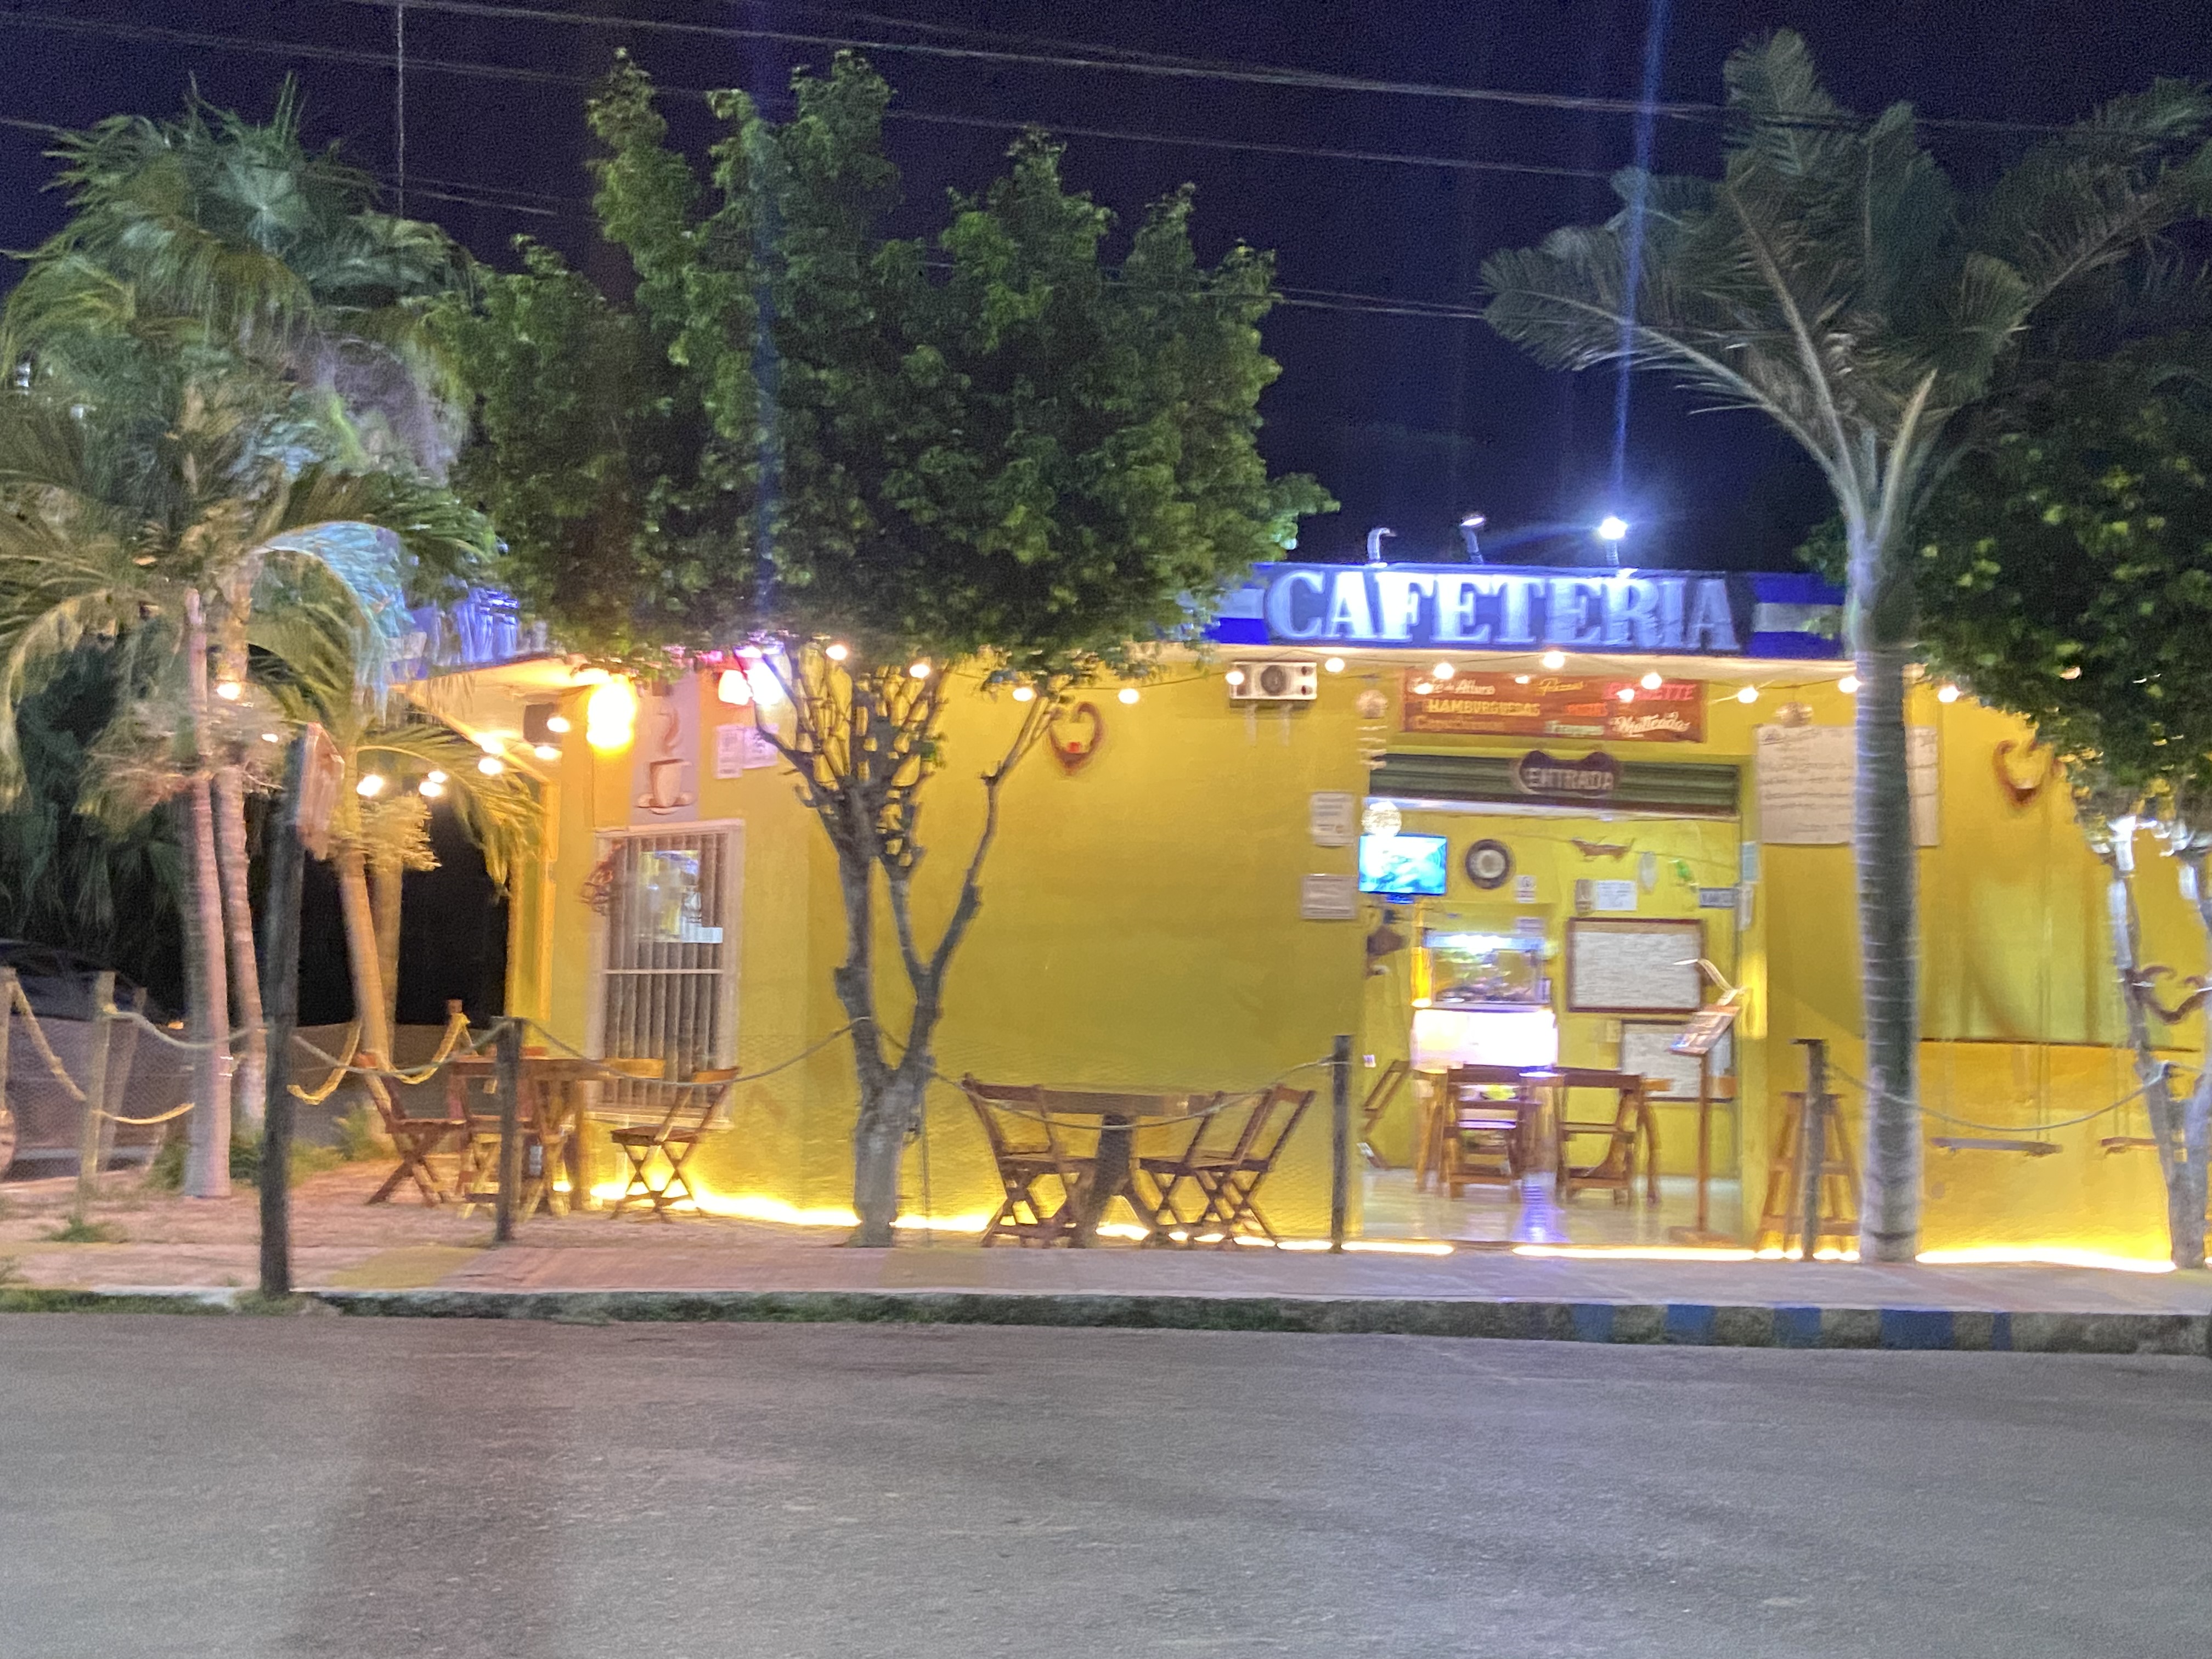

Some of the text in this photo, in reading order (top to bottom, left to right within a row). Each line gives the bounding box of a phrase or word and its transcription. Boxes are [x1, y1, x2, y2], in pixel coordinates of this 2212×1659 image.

[1266, 568, 1741, 651] CAFETERIA
[1424, 698, 1541, 717] HAMBURGUESAS
[1526, 768, 1615, 791] ENTRADA
